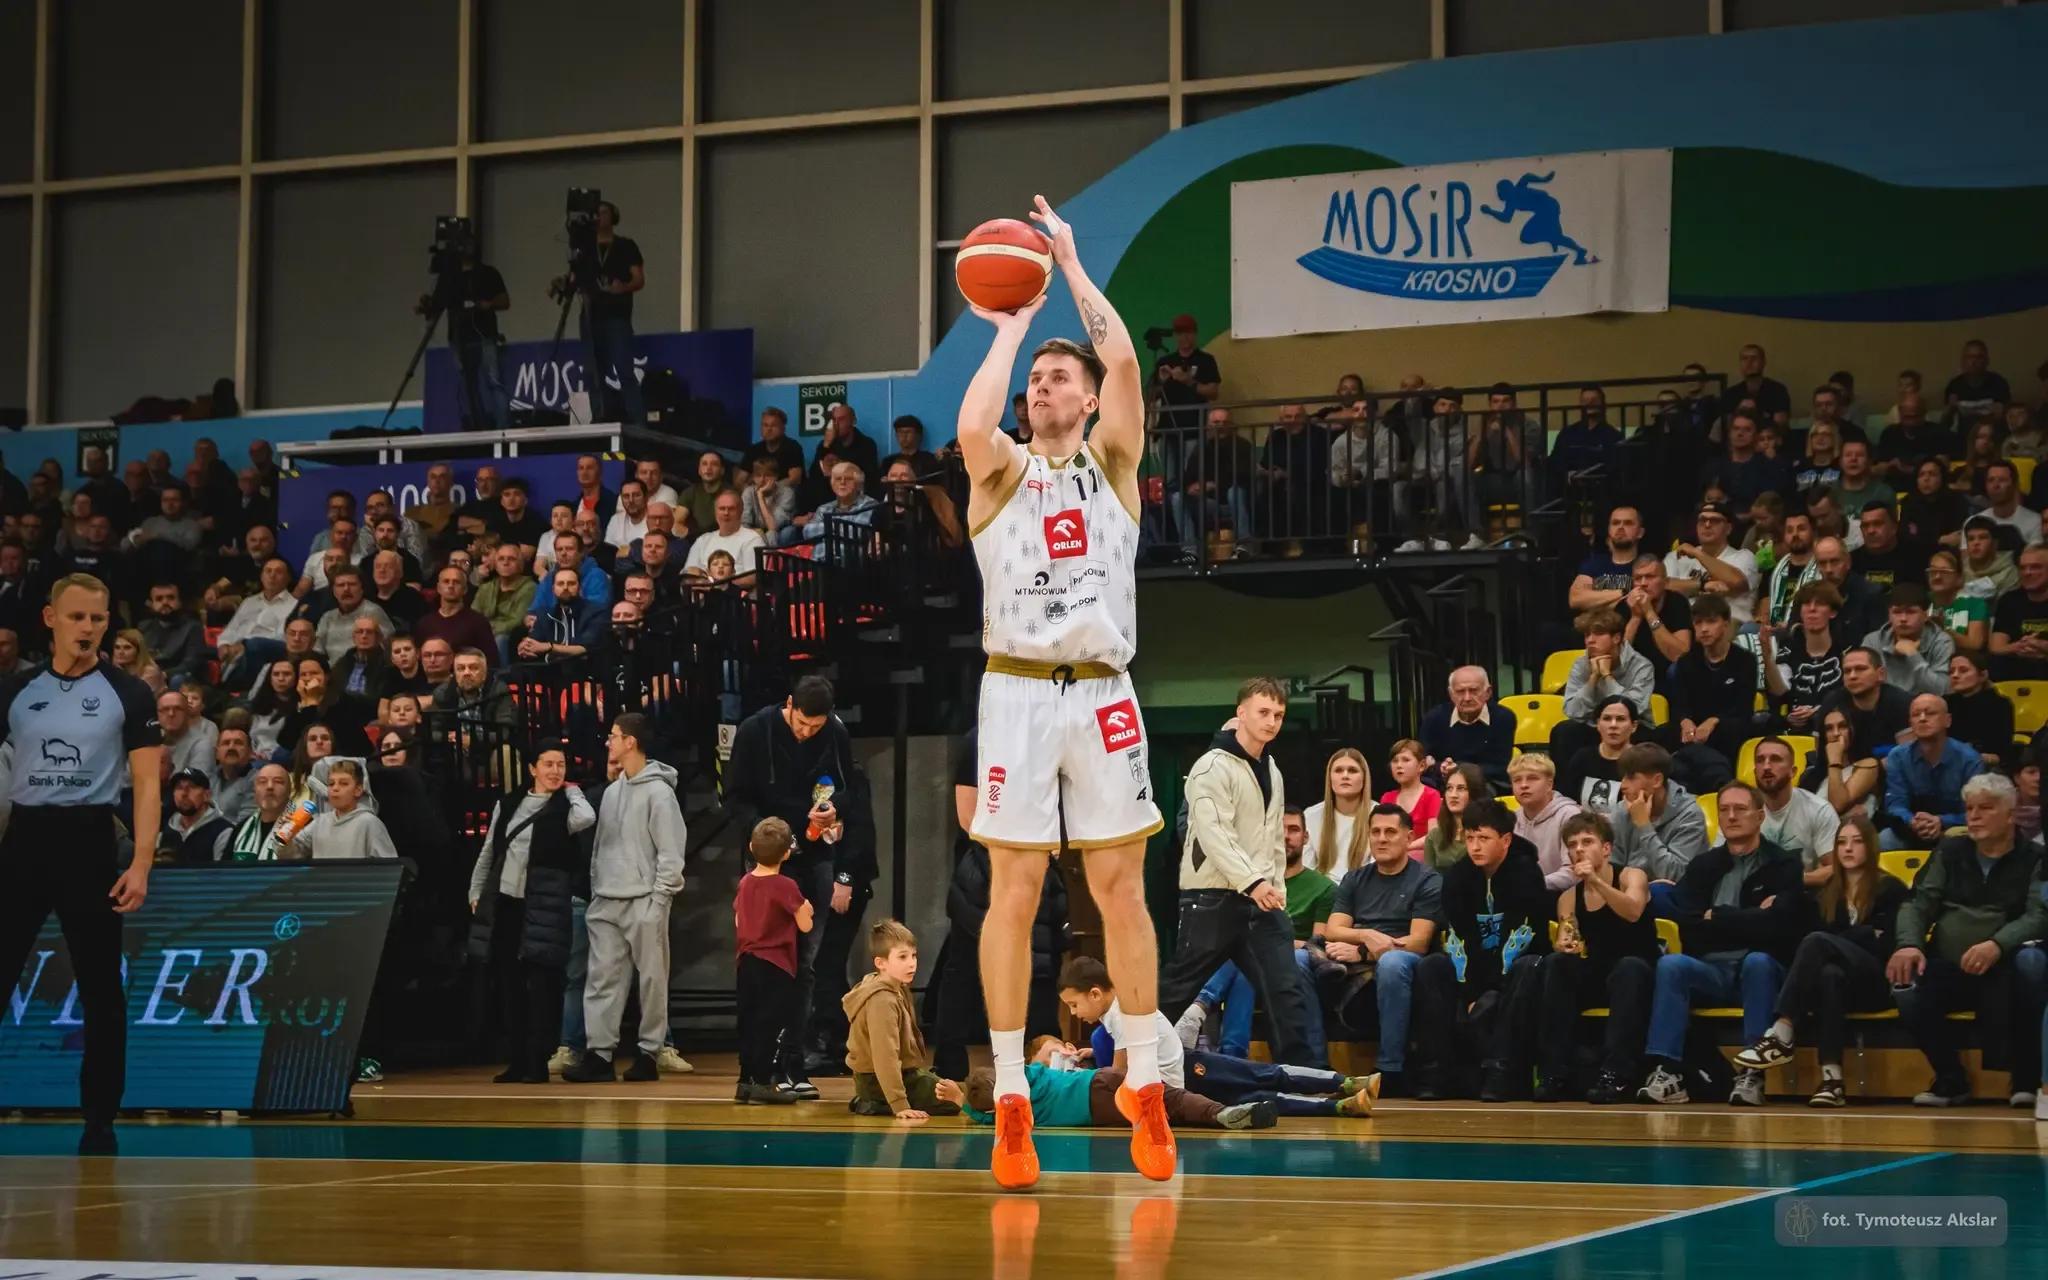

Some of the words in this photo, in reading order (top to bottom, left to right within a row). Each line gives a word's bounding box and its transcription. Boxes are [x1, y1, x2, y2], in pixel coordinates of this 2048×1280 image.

[1402, 266, 1516, 294] KROSNO
[801, 384, 846, 398] SEKTOR
[1072, 468, 1099, 501] 11
[1053, 540, 1083, 551] ORLEN
[1110, 728, 1137, 743] ORLEN
[29, 775, 54, 787] Bank
[57, 775, 92, 788] Pekao
